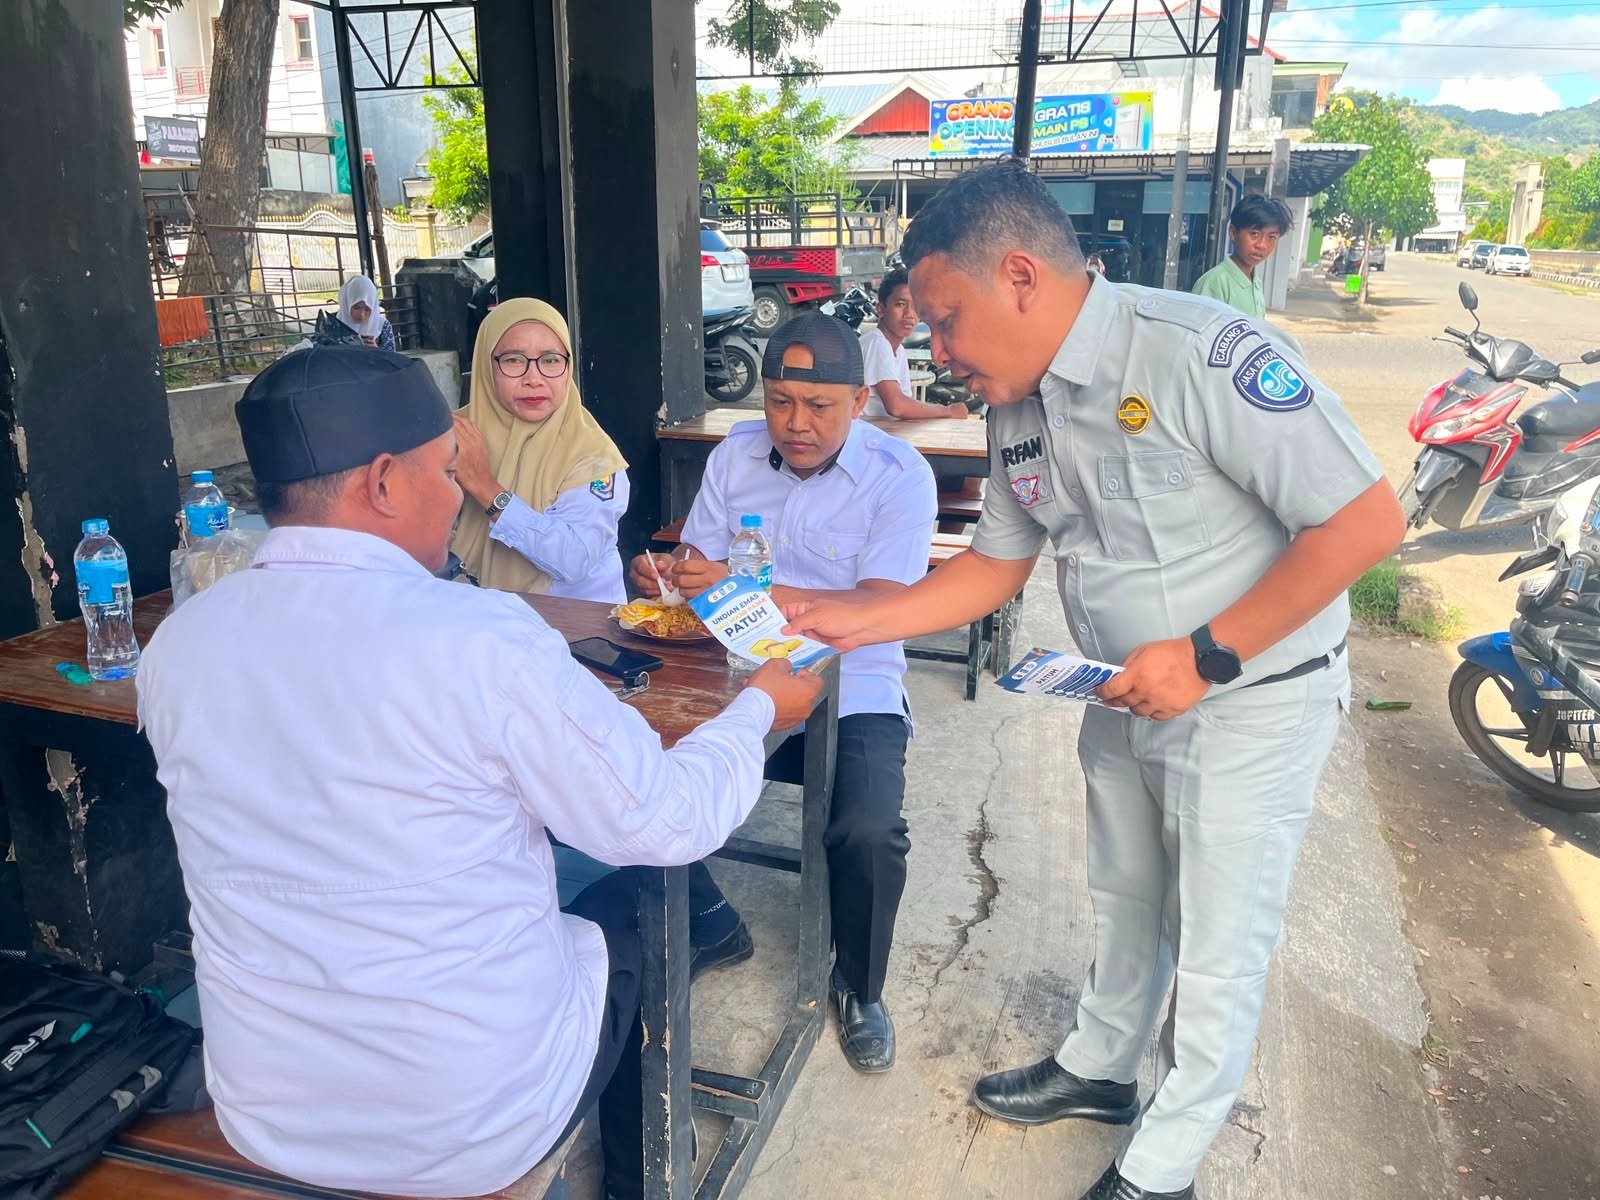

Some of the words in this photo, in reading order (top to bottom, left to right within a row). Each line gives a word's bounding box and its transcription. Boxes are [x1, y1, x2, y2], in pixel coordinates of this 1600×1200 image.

[946, 101, 1014, 121] GRAND
[1035, 101, 1091, 122] GRATIS
[1033, 122, 1067, 138] MAIN
[1217, 327, 1241, 361] CABANG
[1241, 366, 1258, 387] JASA
[712, 605, 740, 625] UNDIAN
[740, 592, 760, 609] EMAS
[724, 606, 768, 638] PATUH
[1556, 709, 1595, 721] JUPITER
